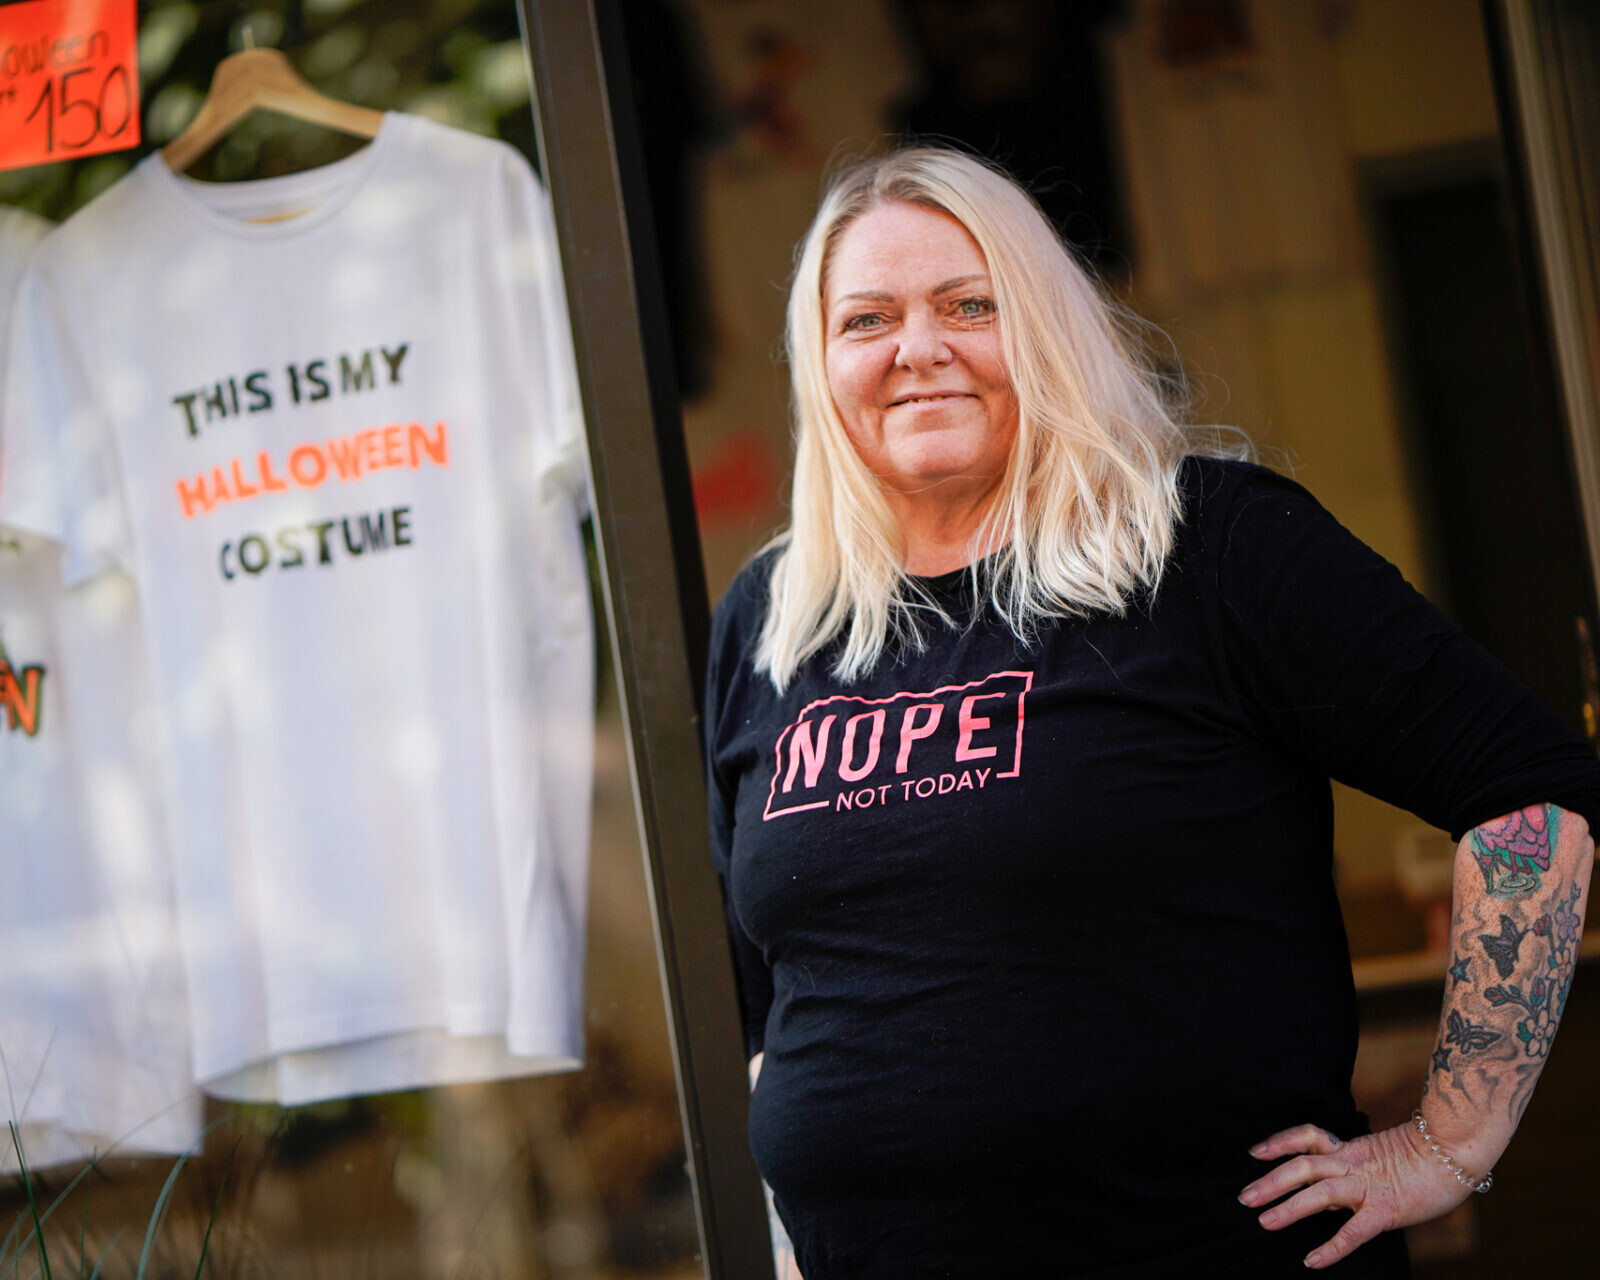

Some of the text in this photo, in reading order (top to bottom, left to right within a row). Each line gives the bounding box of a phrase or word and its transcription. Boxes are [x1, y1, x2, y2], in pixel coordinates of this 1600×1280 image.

[25, 64, 131, 154] 150
[171, 343, 409, 437] THIS IS MY
[175, 421, 448, 519] HALLOWEEN
[219, 506, 412, 580] COSTUME
[782, 692, 1006, 793] NOPE
[836, 768, 991, 812] NOT TODAY
